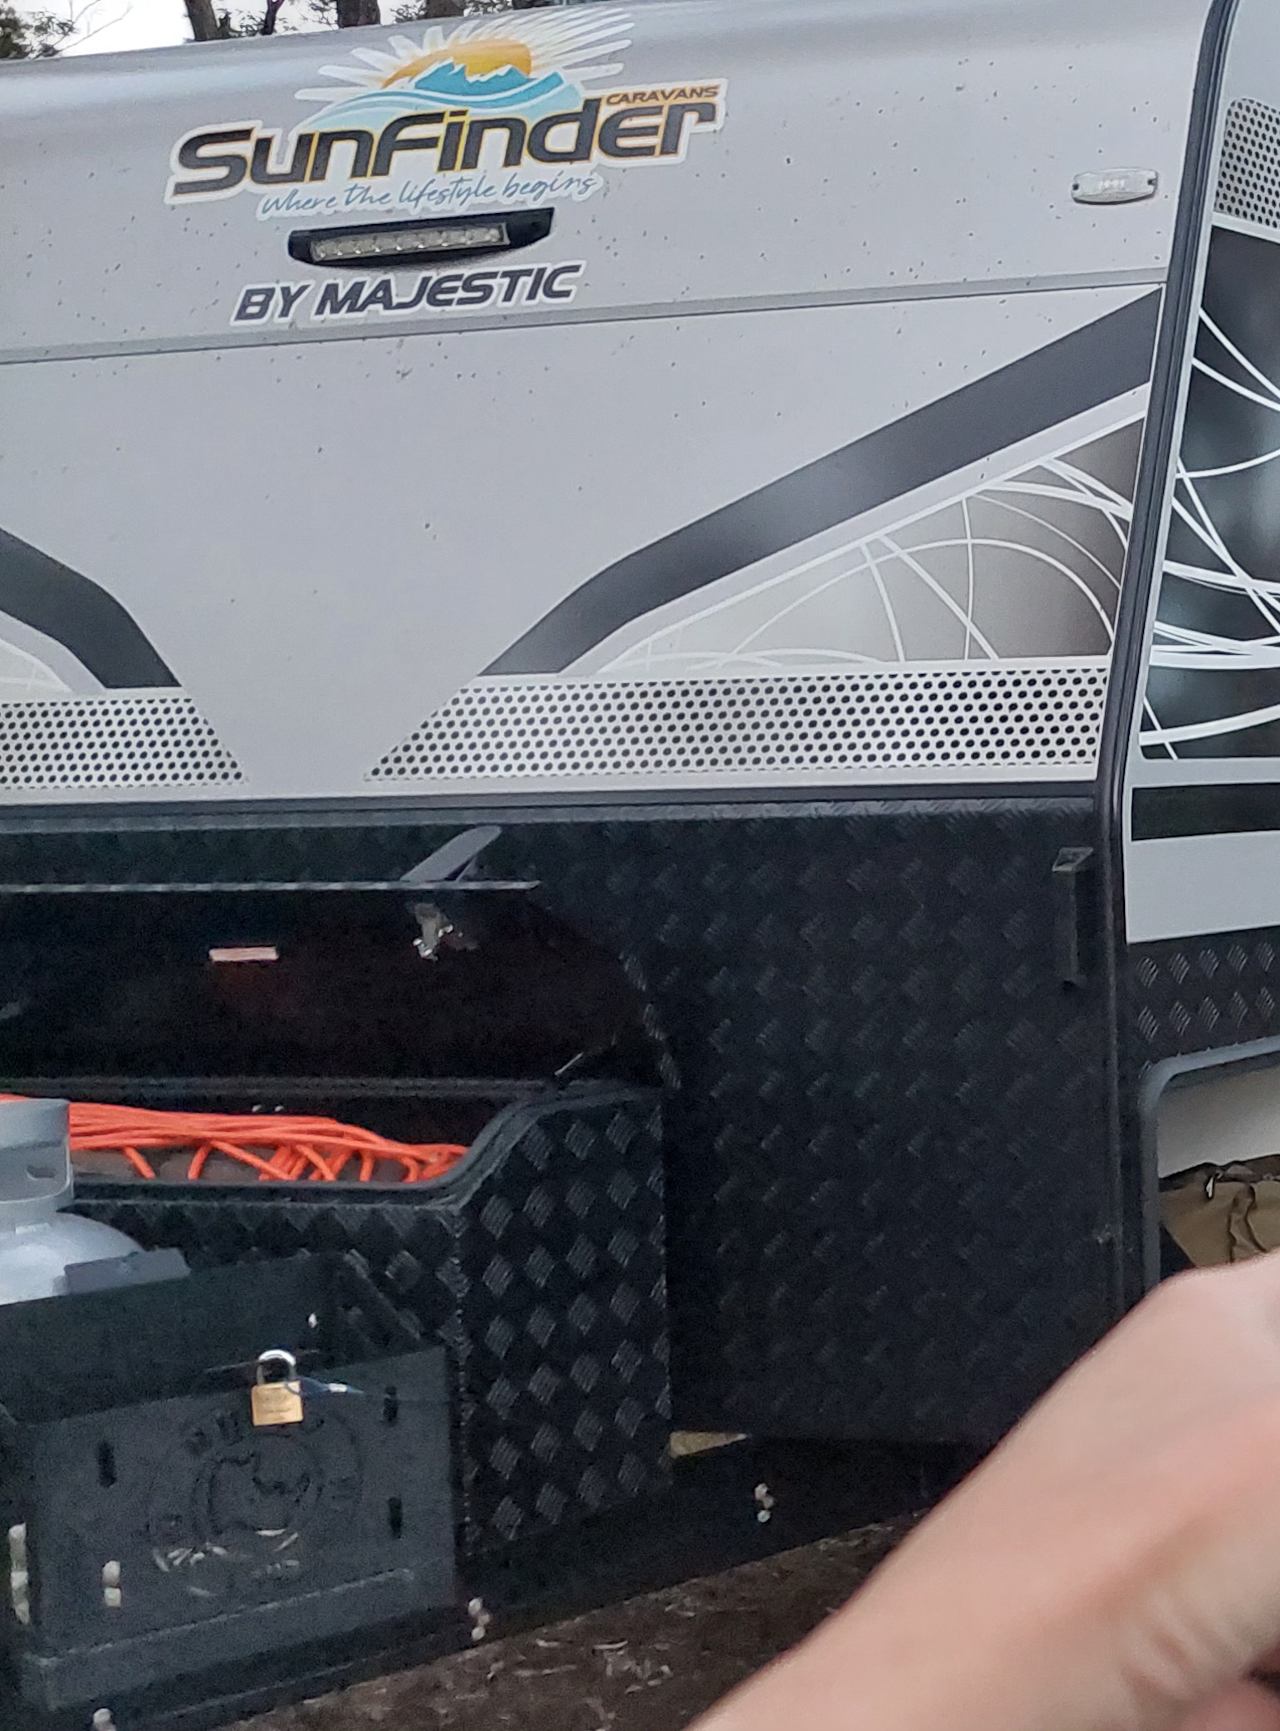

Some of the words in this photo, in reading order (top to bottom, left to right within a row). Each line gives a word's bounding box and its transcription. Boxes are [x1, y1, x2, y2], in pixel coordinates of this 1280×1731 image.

[606, 85, 719, 106] CARAVANS
[261, 188, 337, 214] Where
[344, 182, 392, 207] the
[399, 175, 497, 208] lifestyle
[502, 170, 597, 201] begins
[234, 284, 310, 322] BY
[314, 264, 582, 316] MAJESTIC
